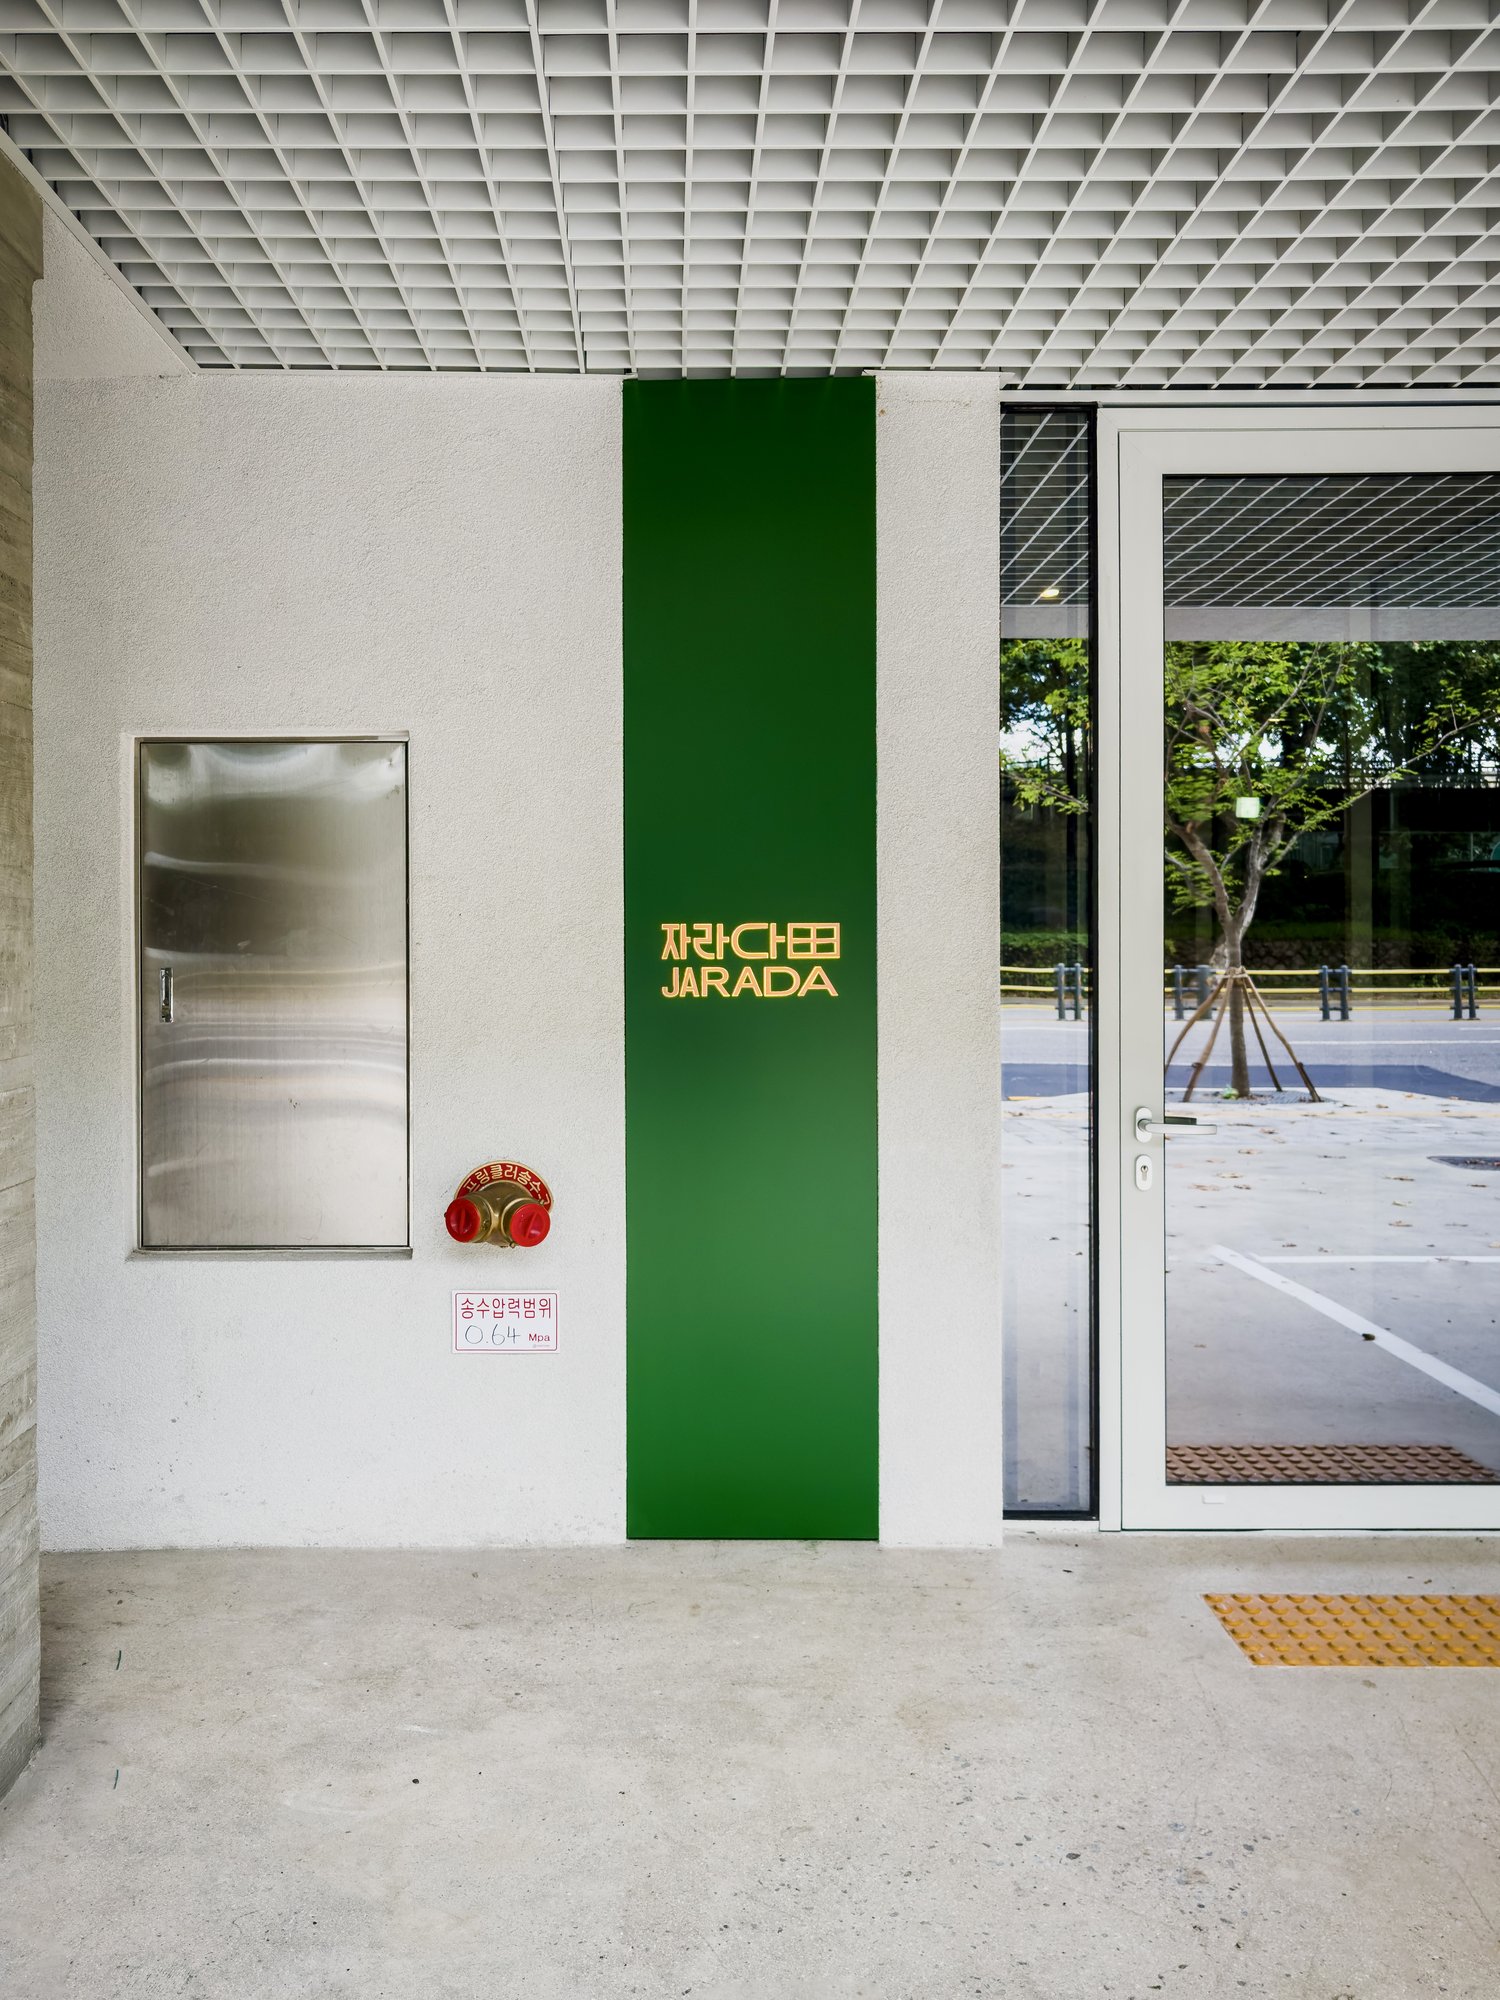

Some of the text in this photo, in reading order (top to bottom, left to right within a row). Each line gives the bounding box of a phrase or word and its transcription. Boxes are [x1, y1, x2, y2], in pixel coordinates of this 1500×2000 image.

[661, 965, 839, 998] JARADA
[460, 1297, 551, 1319] 송수압력범위
[464, 1323, 550, 1346] 0.64 Mpa
